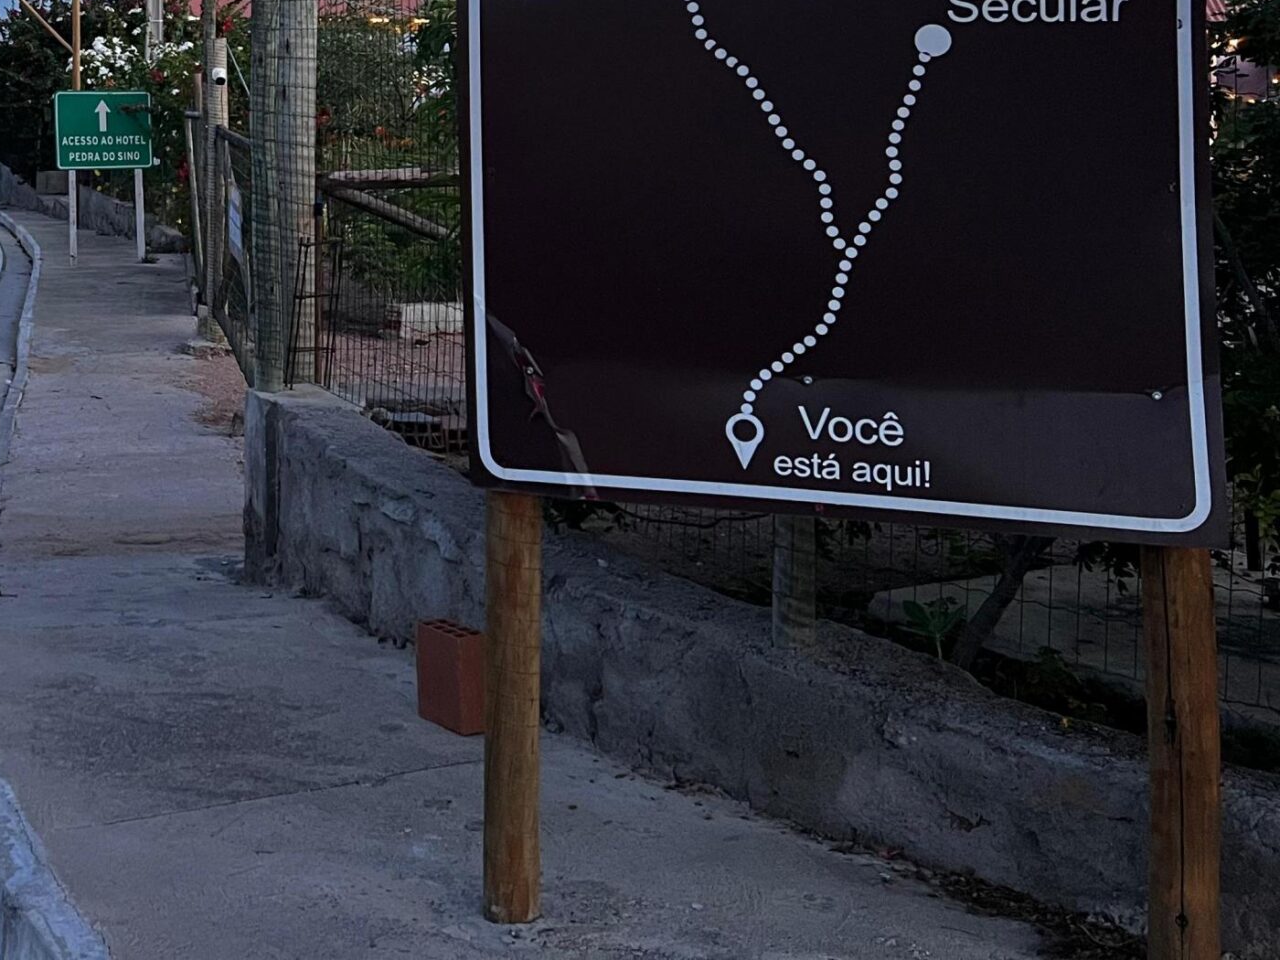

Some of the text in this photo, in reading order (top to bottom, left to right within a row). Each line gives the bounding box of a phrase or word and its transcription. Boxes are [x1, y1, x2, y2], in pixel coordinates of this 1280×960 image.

[61, 135, 146, 146] ACESSO AO HOTEL
[68, 151, 140, 162] PEDRA DO SINO
[797, 405, 904, 447] Você
[773, 453, 931, 492] está aqui!
